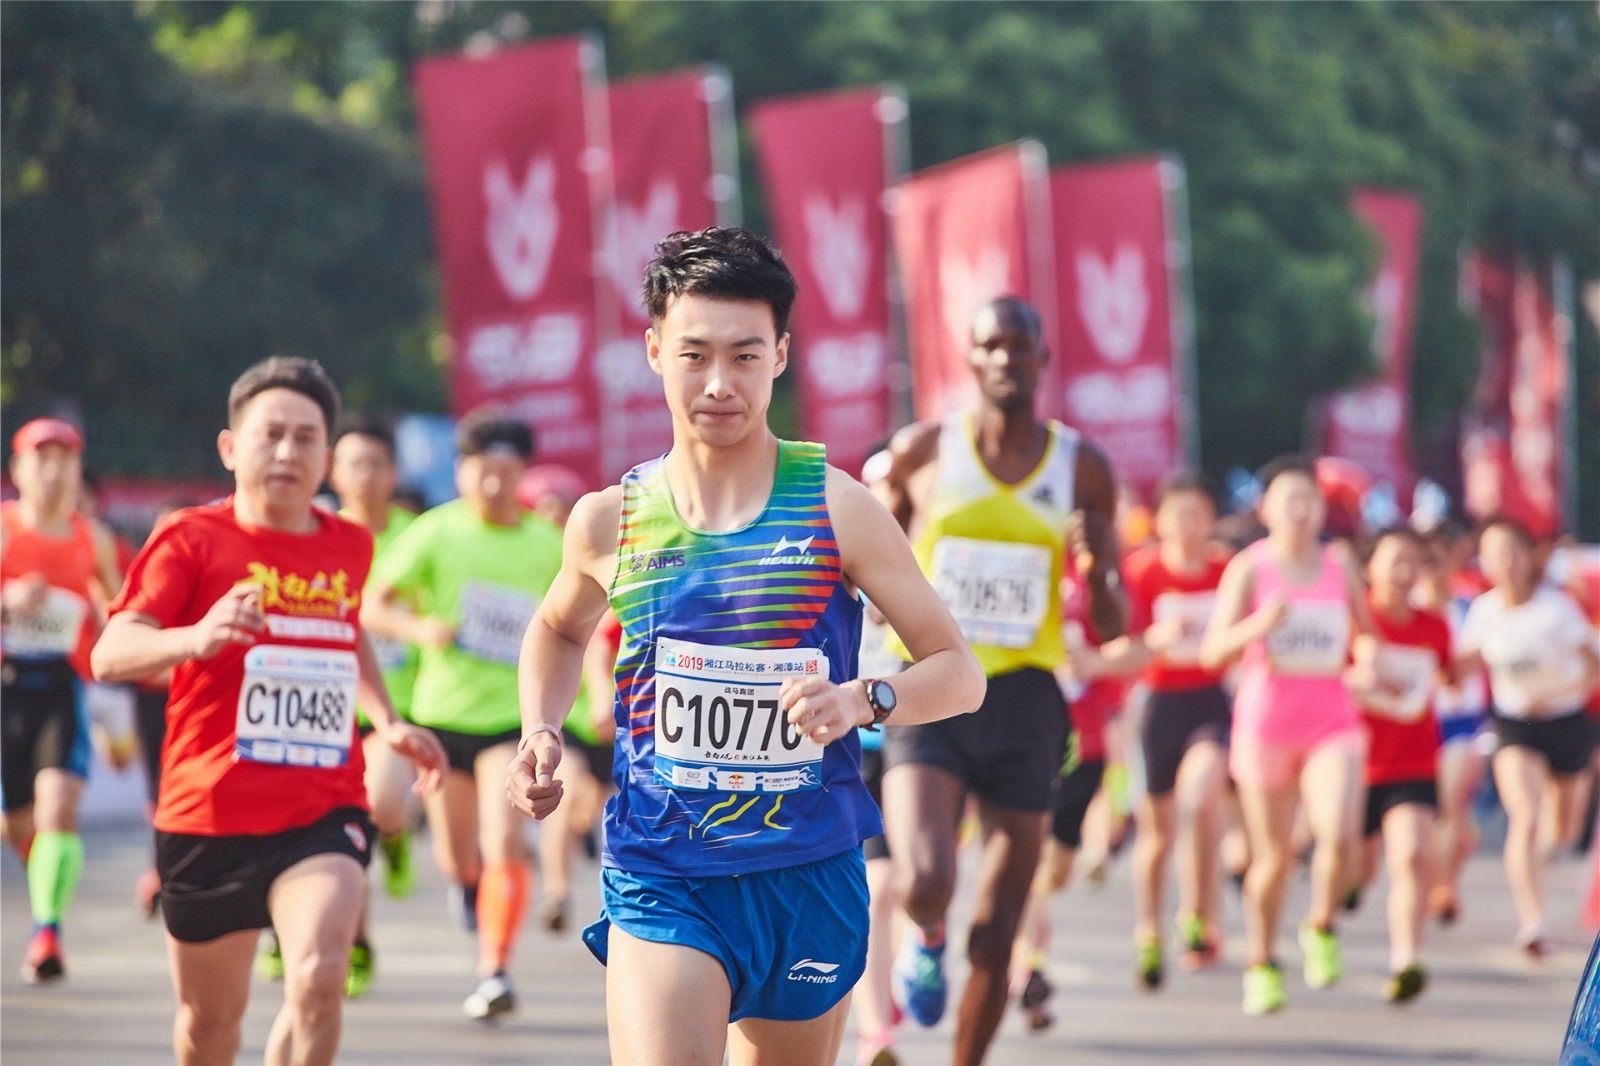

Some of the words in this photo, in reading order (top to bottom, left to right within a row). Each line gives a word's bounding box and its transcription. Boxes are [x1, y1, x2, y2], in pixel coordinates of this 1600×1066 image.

[647, 554, 686, 570] AIMS
[758, 555, 816, 566] HEALTH
[678, 654, 703, 671] 2019
[245, 683, 347, 733] C10488
[787, 972, 839, 984] LI-NING
